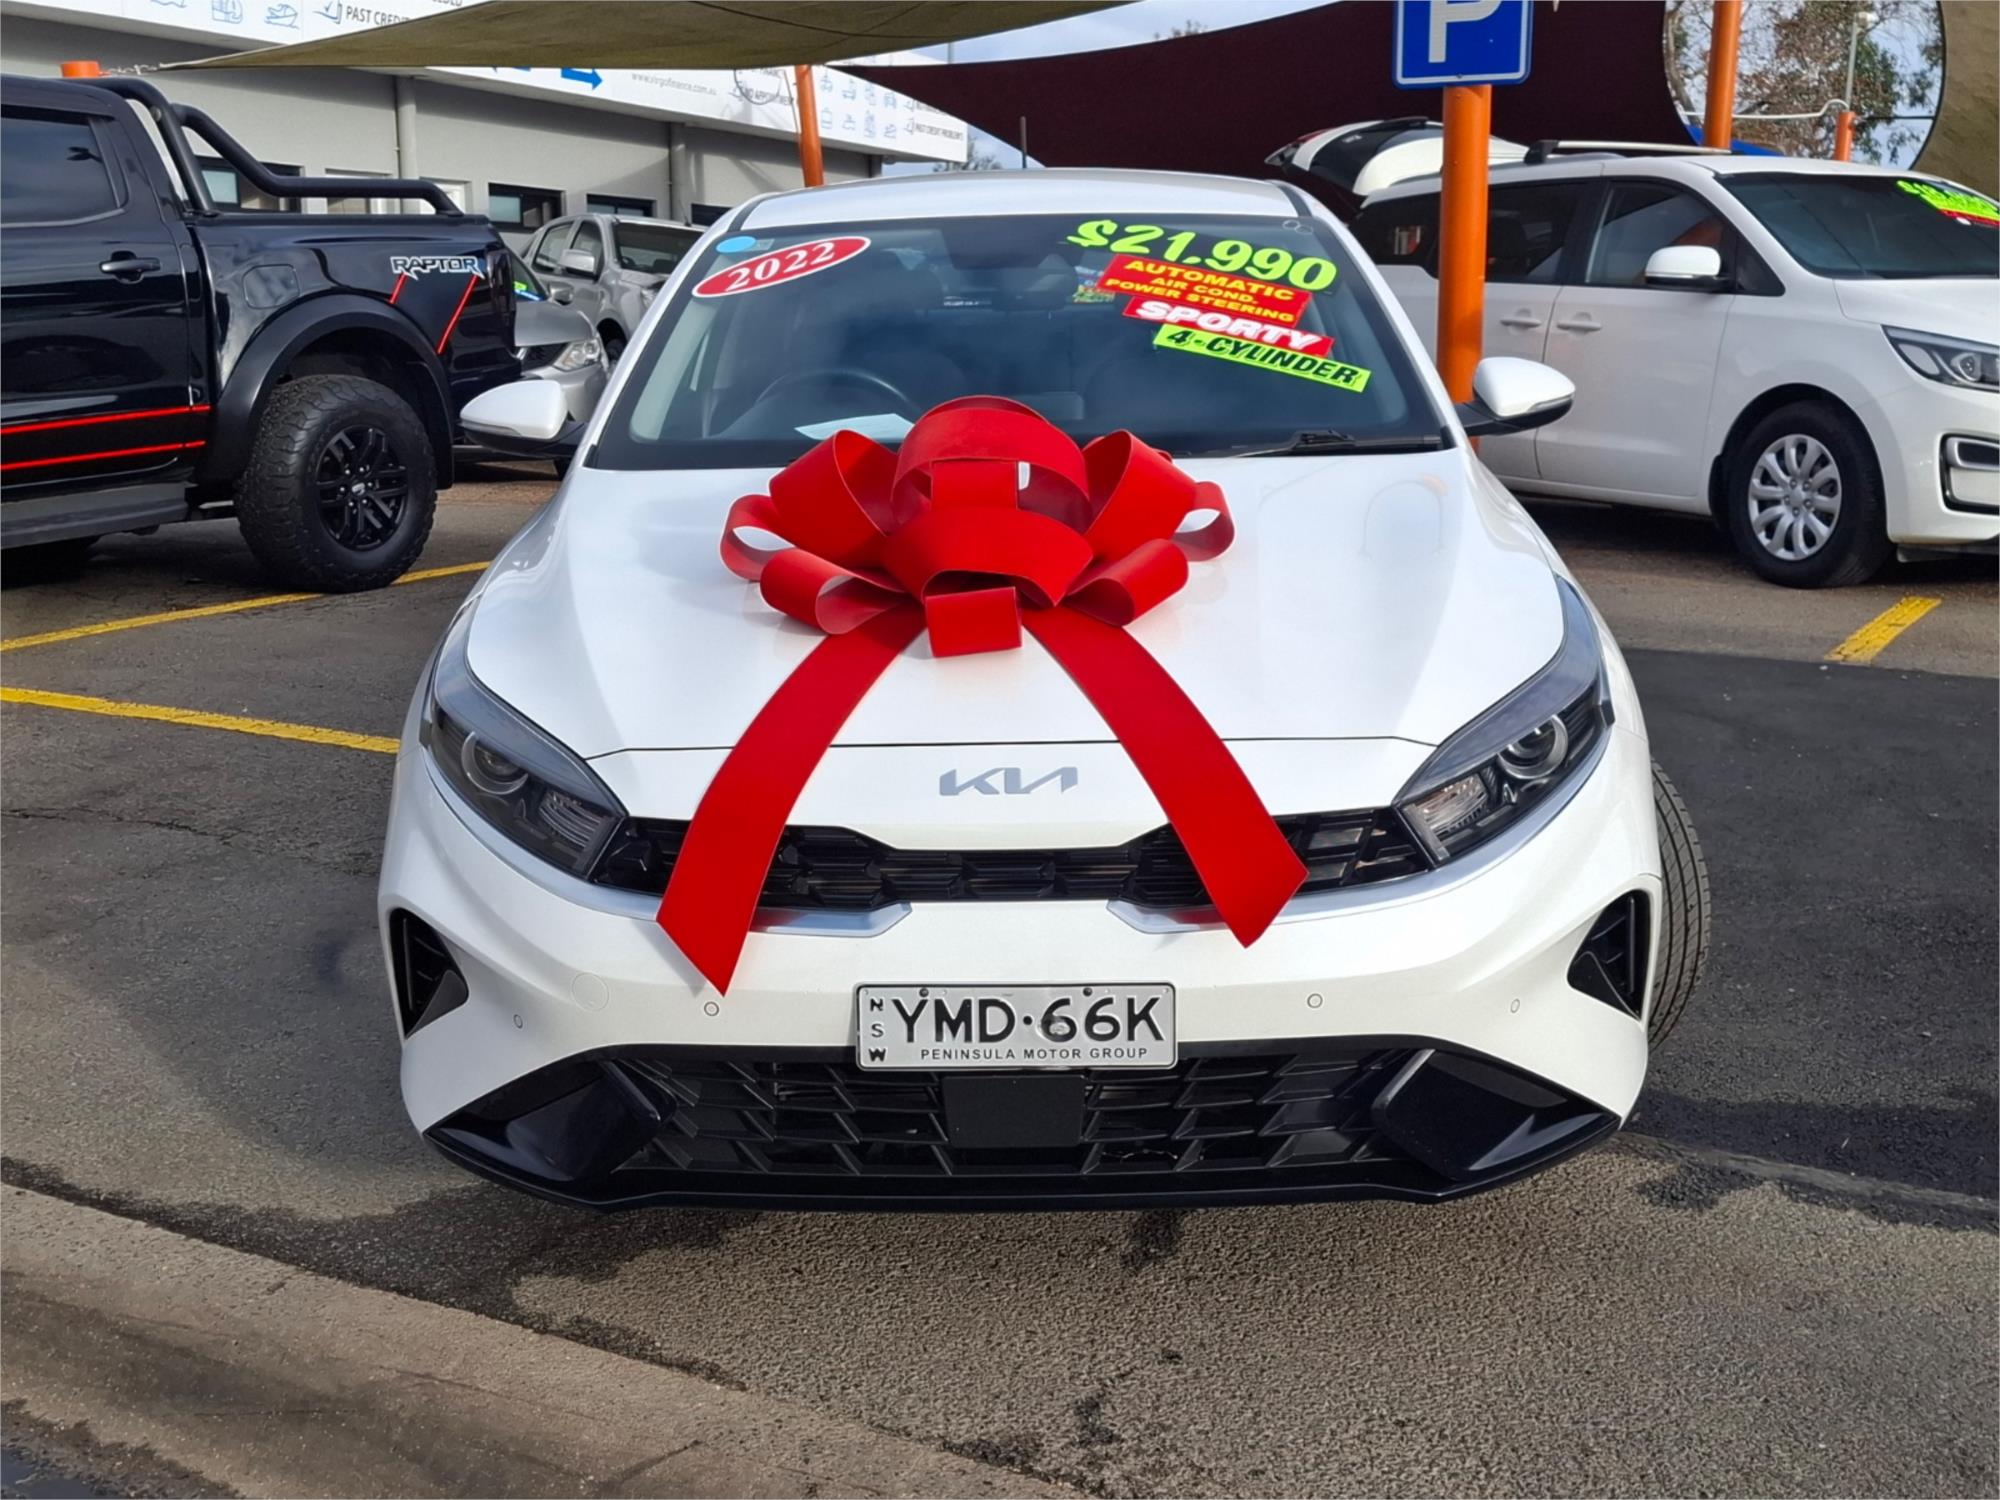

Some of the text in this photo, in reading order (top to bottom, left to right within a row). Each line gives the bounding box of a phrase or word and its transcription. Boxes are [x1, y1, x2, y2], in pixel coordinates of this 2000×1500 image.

[346, 5, 411, 25] PAST CRED
[390, 256, 485, 280] RAPTOR
[725, 242, 835, 292] 2022
[1124, 260, 1296, 301] AUTOMATIC
[1105, 279, 1181, 299] POWER
[1186, 292, 1295, 322] STEERING
[1151, 277, 1259, 304] AIR COND.
[1136, 301, 1321, 351] SPORTY
[920, 1047, 1148, 1060] PENINSULA MOTOR GROUP
